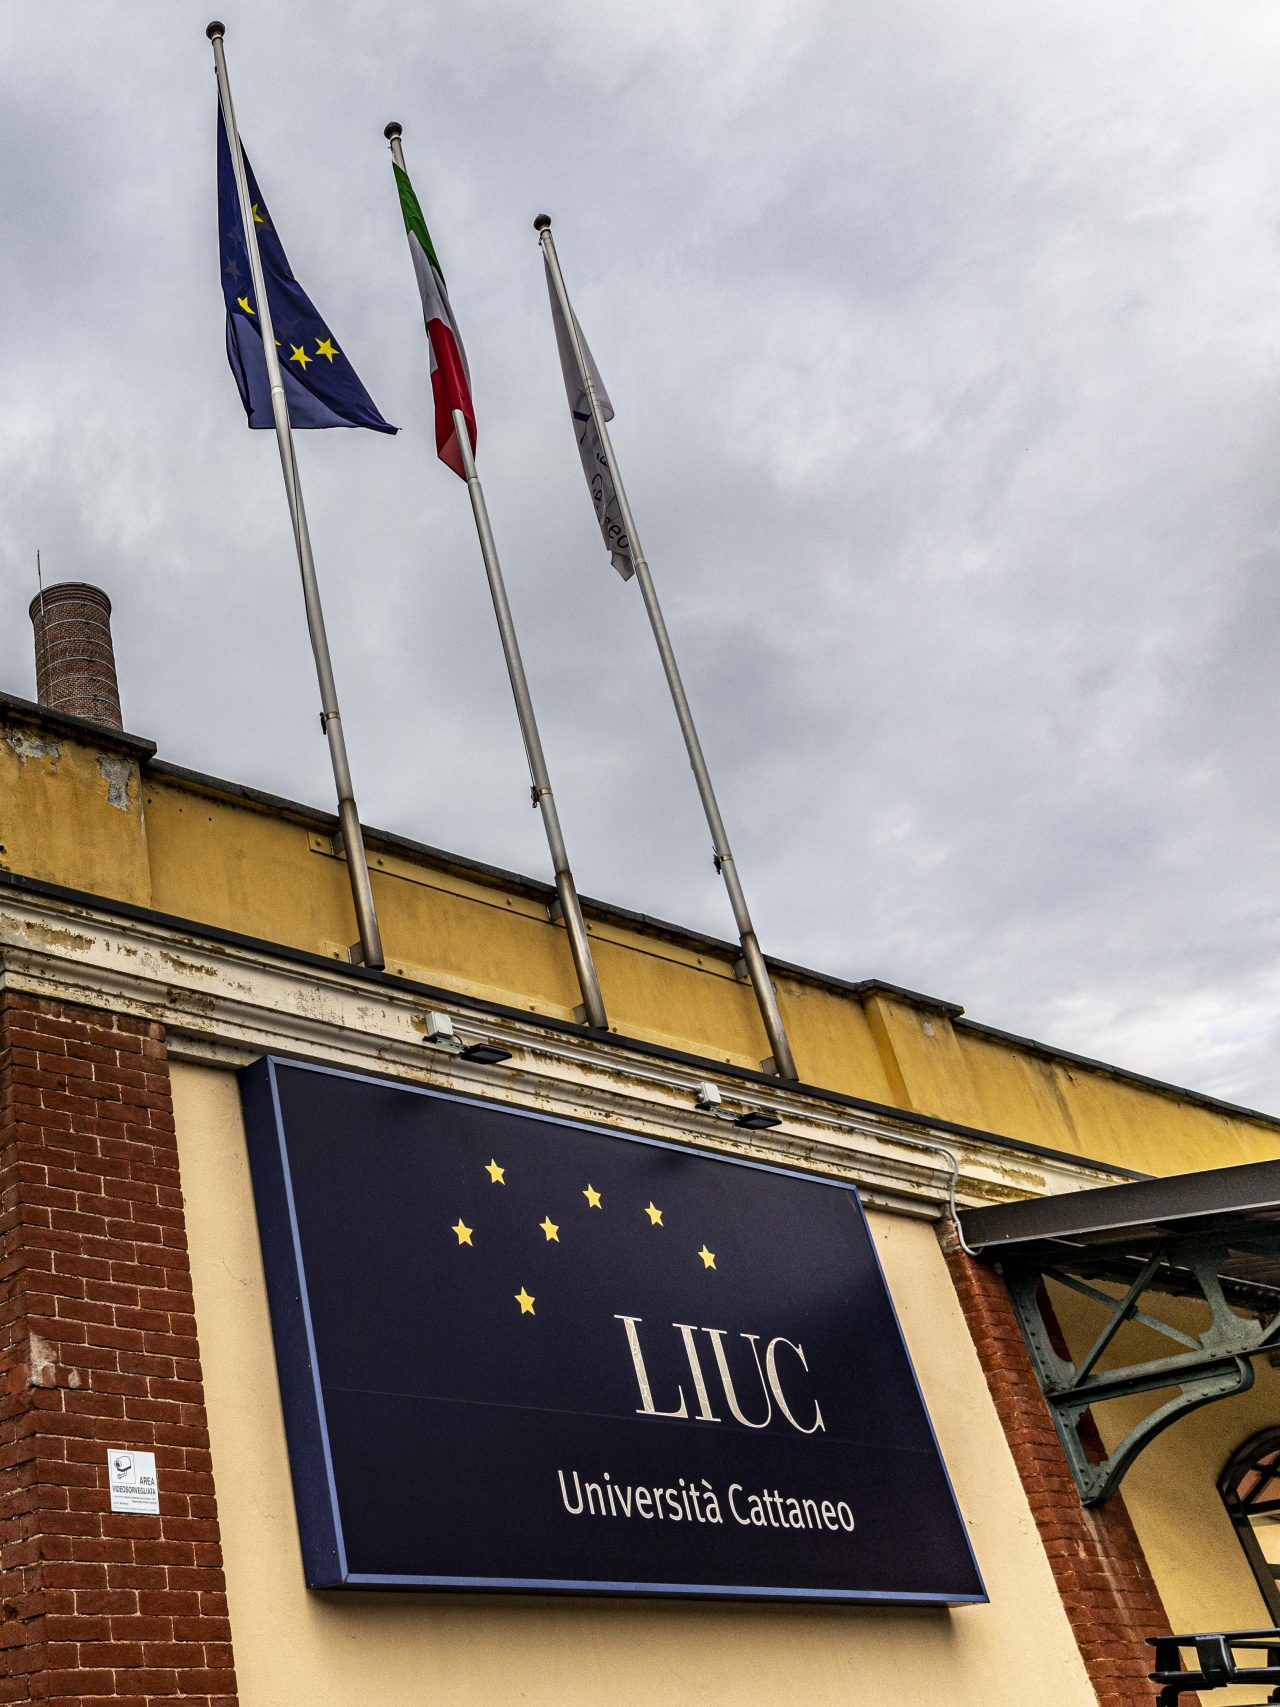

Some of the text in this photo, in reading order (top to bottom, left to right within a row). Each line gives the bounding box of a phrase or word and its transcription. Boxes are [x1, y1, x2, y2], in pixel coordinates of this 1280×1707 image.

[614, 1314, 826, 1434] LIUC
[139, 1476, 155, 1485] AREA
[557, 1469, 855, 1532] Università Cattaneo
